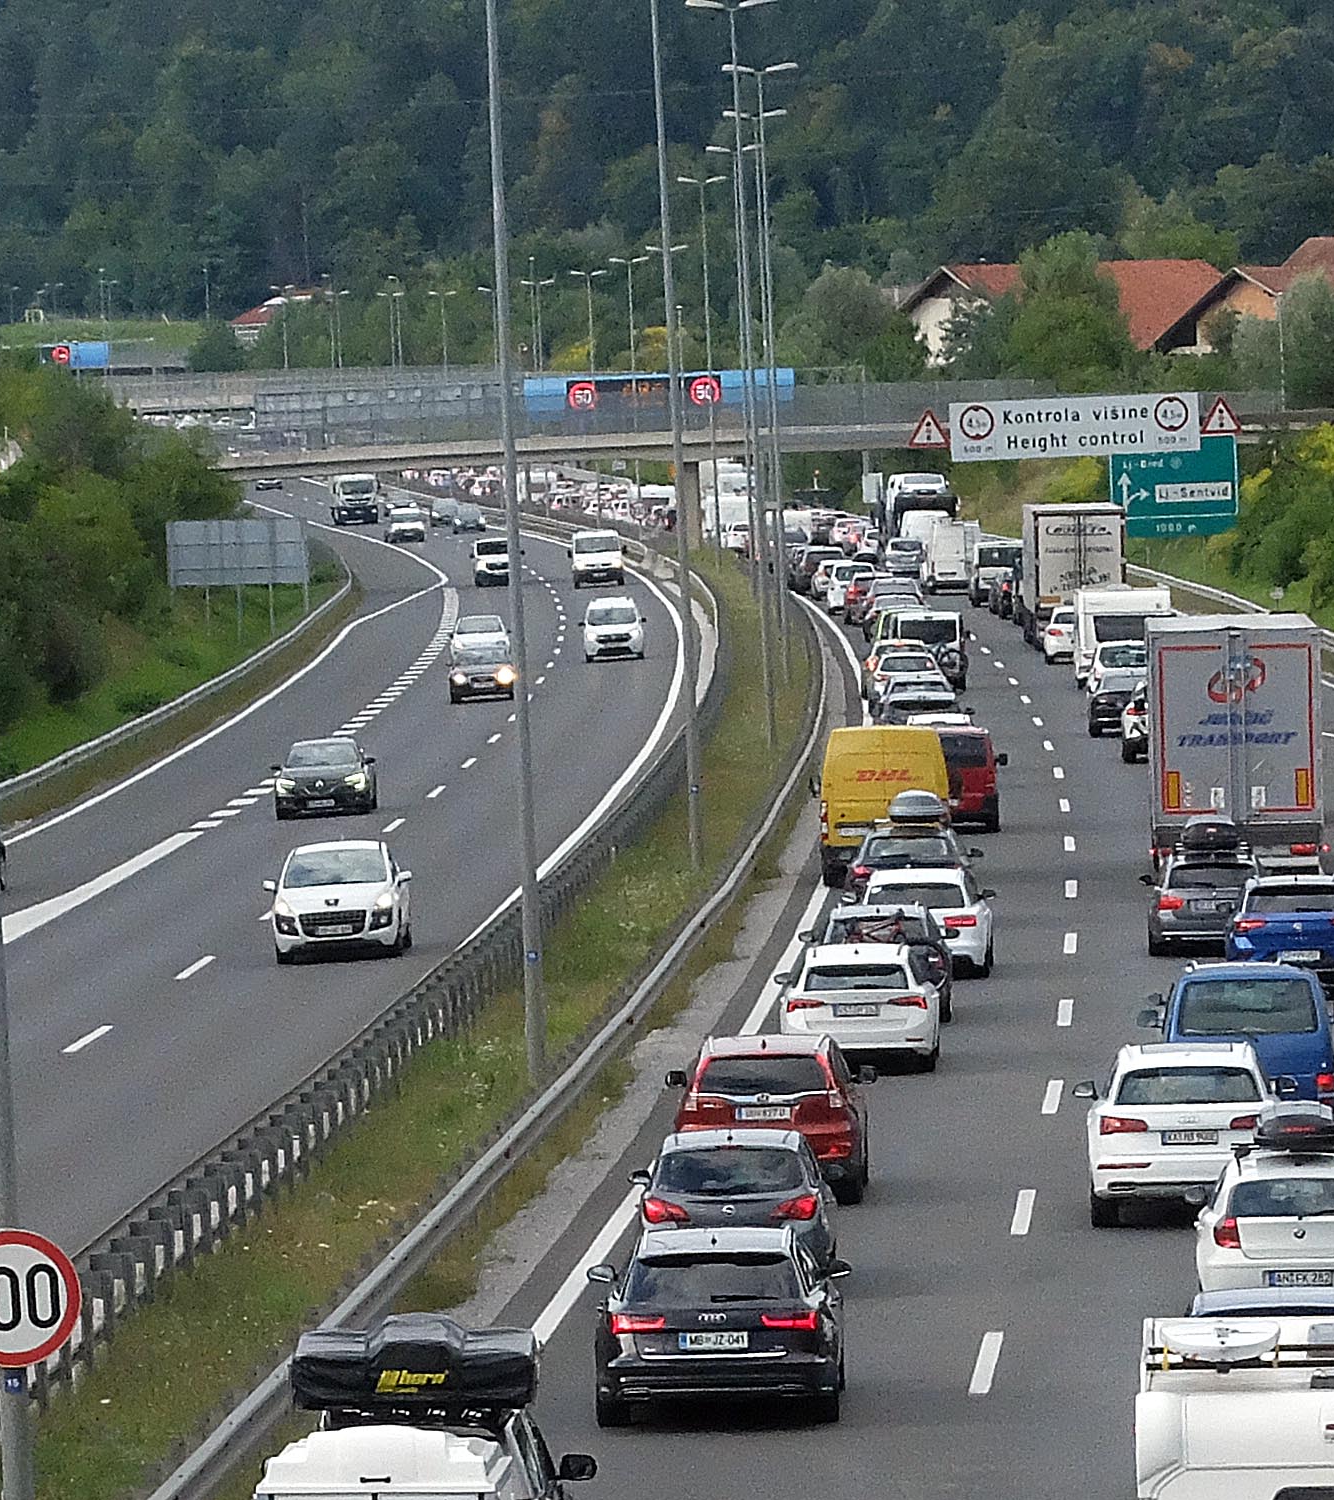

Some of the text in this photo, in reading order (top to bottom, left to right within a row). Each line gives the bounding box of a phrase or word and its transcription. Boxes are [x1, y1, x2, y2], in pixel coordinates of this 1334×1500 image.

[1003, 404, 1149, 425] Kontrola višine
[1006, 430, 1145, 453] Height control
[856, 769, 910, 782] DHL
